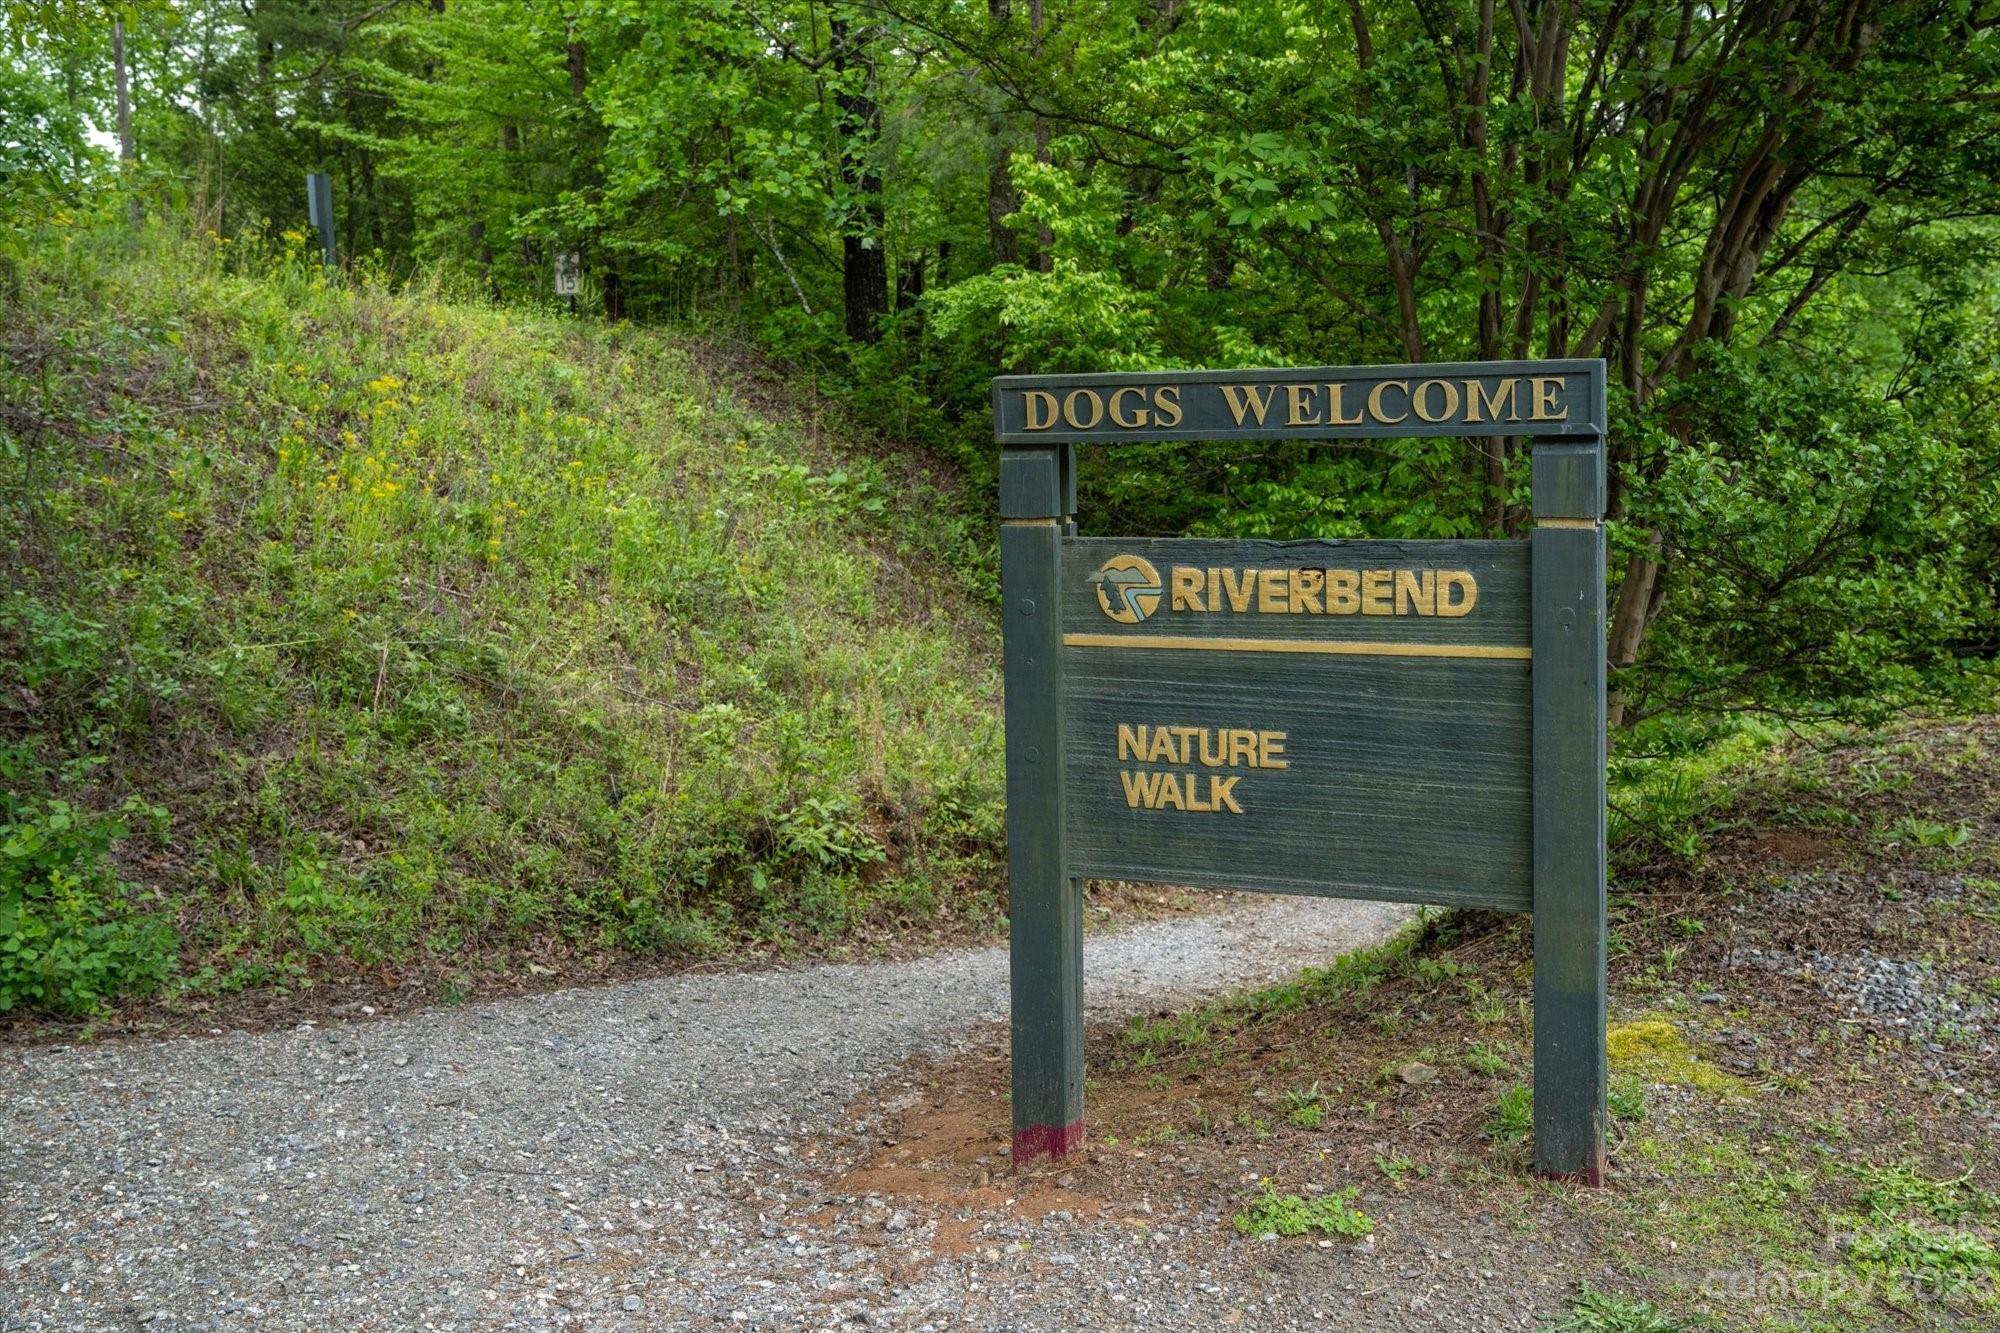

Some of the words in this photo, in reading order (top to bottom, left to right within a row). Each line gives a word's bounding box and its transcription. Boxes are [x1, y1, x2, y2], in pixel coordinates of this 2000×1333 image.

[1021, 386, 1184, 431] DOGS
[1219, 376, 1568, 427] WELCOME
[1171, 566, 1478, 617] RIVERBEND
[1117, 724, 1289, 769] NATURE
[1119, 771, 1243, 814] WALK
